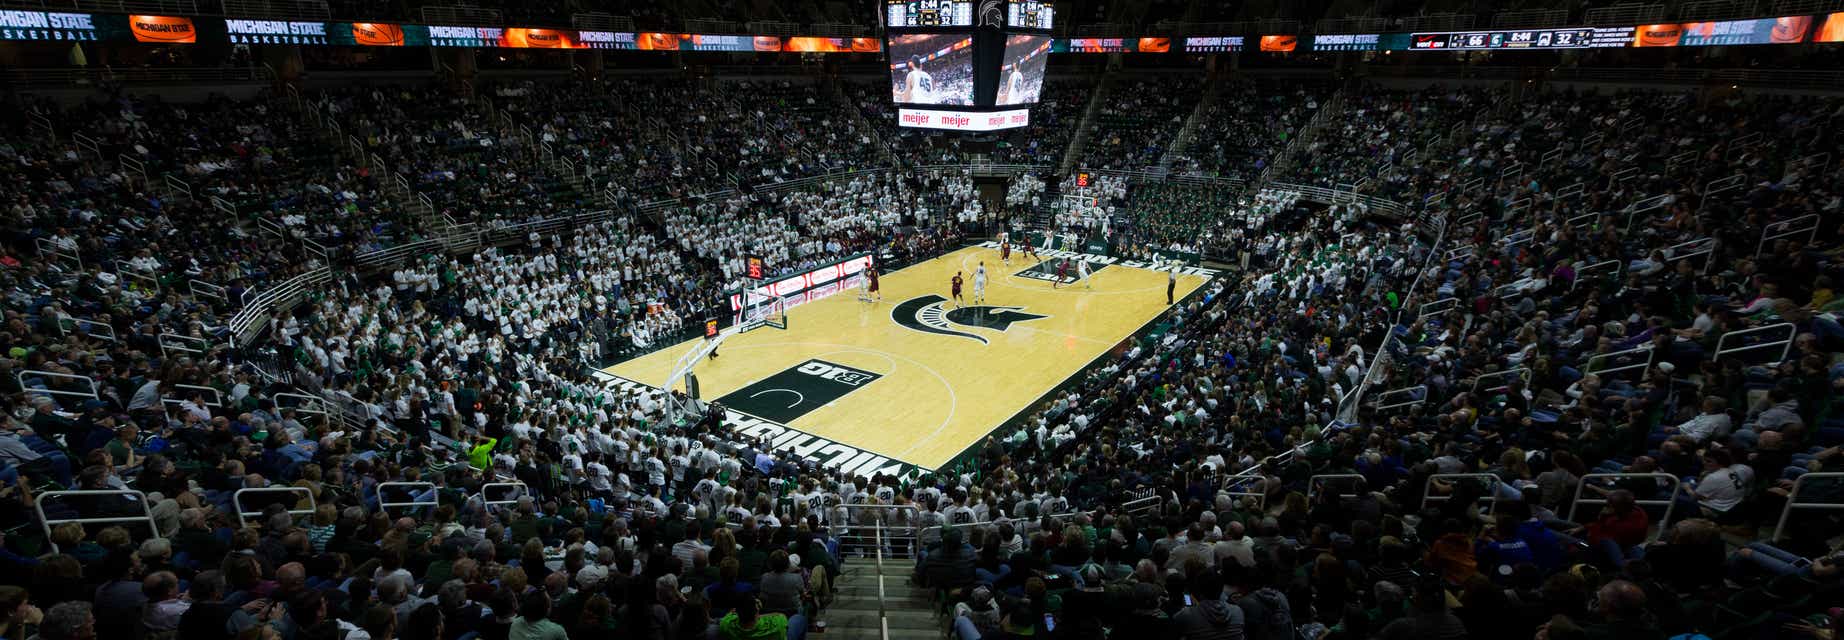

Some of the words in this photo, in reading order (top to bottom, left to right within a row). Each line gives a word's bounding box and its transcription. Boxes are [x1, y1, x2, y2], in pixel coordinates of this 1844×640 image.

[48, 12, 95, 29] STATE
[941, 17, 951, 25] 32
[225, 19, 289, 35] MICHIGAN
[290, 21, 327, 36] STATE
[429, 26, 476, 39] MICHIGAN
[477, 28, 503, 39] STATE
[230, 35, 328, 45] BASKETBALL
[579, 31, 614, 42] MICHIGAN
[1186, 37, 1221, 46] MICHIGAN
[1314, 35, 1354, 44] MICHIGAN
[1355, 35, 1380, 43] STATE
[1469, 36, 1484, 46] 66
[1512, 32, 1532, 41] 8:44
[1557, 33, 1573, 44] 32
[919, 77, 931, 92] 45
[903, 112, 930, 125] meijer
[941, 114, 970, 128] meijer
[749, 264, 761, 277] 35
[701, 483, 713, 494] 20
[881, 491, 891, 500] 20
[809, 496, 822, 509] 20
[1052, 501, 1066, 512] 20
[728, 511, 743, 523] 20
[955, 512, 970, 523] 20
